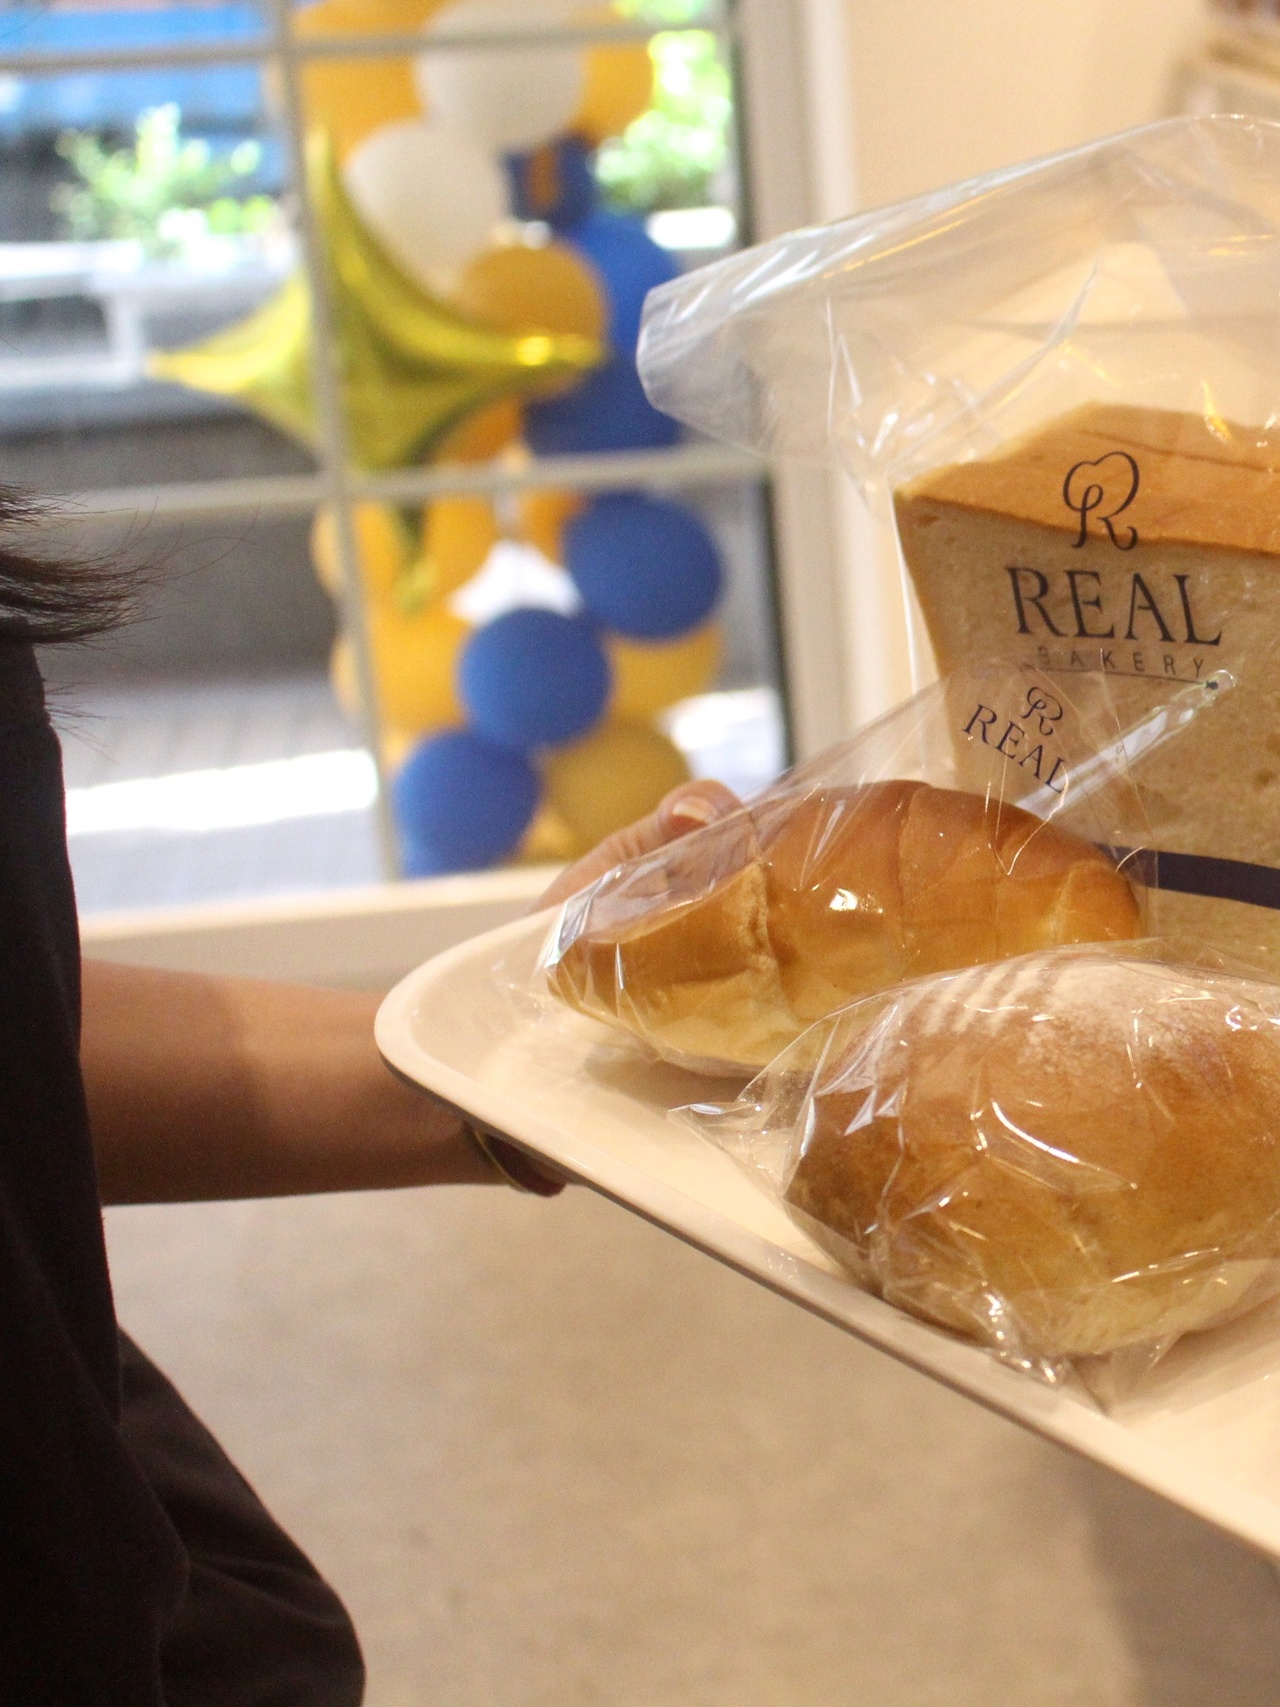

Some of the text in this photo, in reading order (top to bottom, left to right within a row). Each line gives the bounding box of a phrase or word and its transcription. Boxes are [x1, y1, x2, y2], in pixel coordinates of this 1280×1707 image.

[1004, 565, 1223, 646] REAL
[1037, 646, 1204, 678] BAKERY
[962, 703, 1067, 794] REAL
